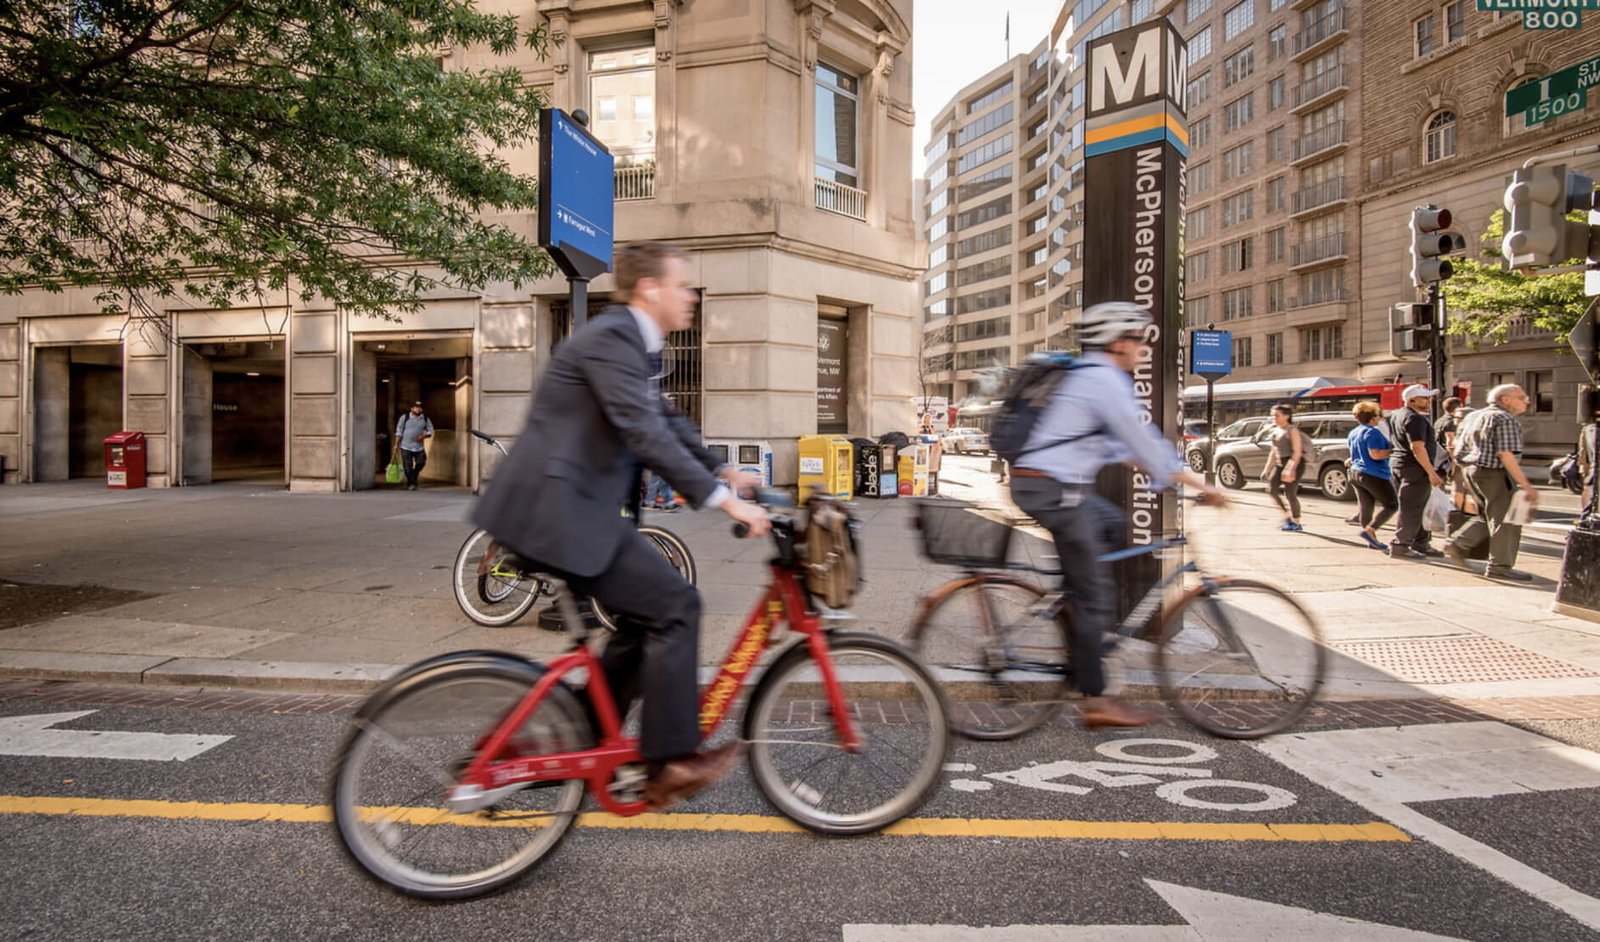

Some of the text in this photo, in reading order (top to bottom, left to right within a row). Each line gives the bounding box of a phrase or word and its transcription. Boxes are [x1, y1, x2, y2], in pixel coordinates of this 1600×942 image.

[1525, 11, 1578, 28] 800
[1091, 26, 1161, 112] M
[1167, 28, 1187, 113] M
[1539, 71, 1600, 102] I NW
[1578, 59, 1600, 77] ST
[1531, 93, 1580, 122] 1500
[1178, 160, 1187, 315] McPherson
[1129, 146, 1162, 545] McPherson Square ation
[1176, 327, 1186, 427] Square
[213, 403, 238, 411] House
[865, 455, 878, 496] blade
